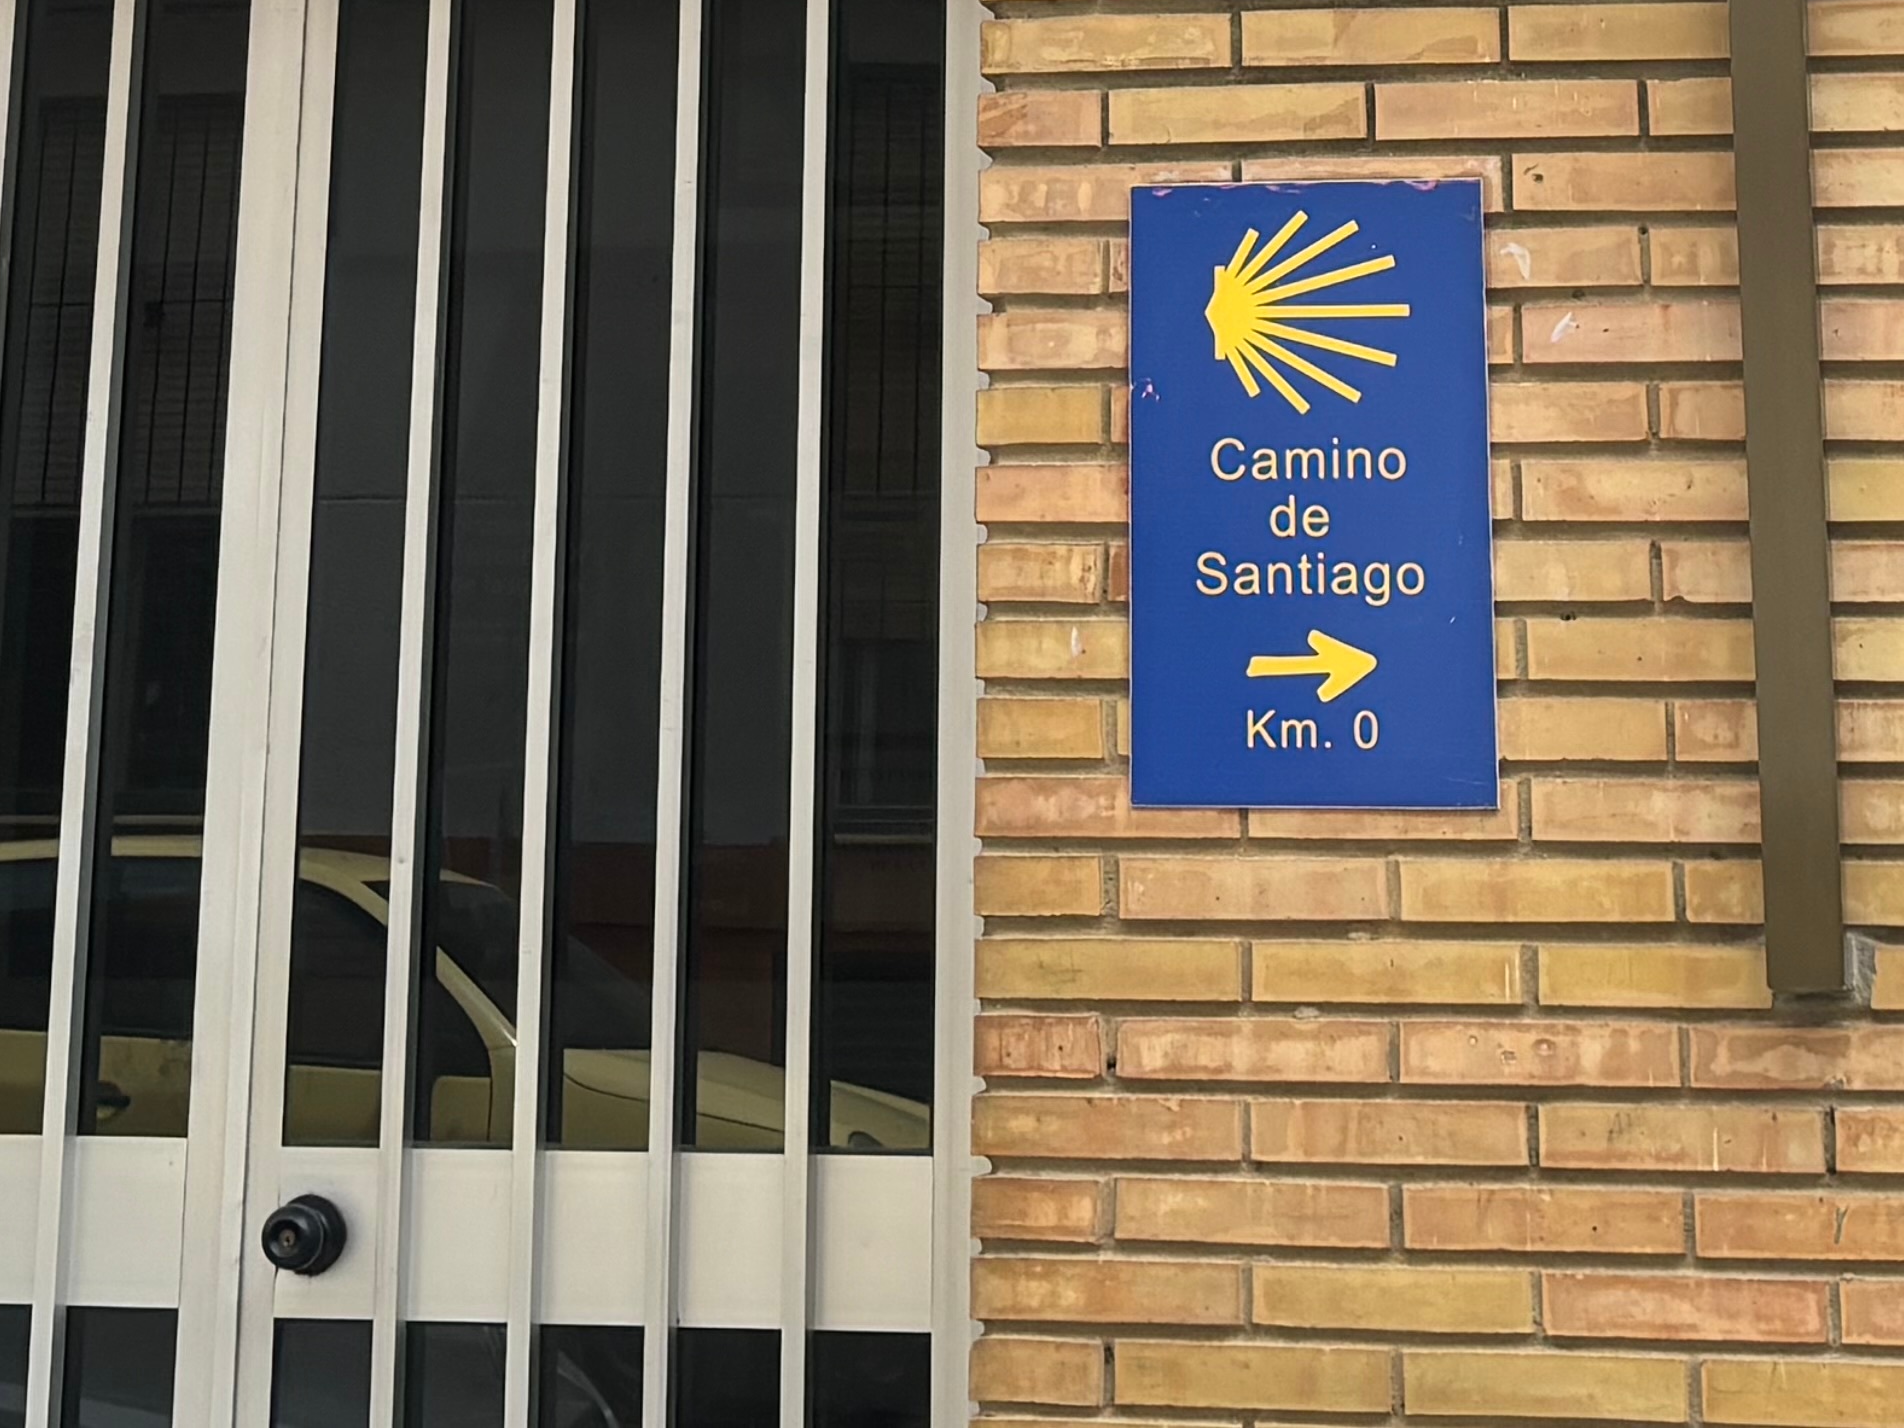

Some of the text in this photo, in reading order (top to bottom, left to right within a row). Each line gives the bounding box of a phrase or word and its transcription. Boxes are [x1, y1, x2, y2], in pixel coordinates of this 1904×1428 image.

[1210, 437, 1407, 481] Camino
[1269, 494, 1330, 538] de
[1196, 551, 1425, 607] Santiago
[1246, 709, 1380, 750] Km. 0
